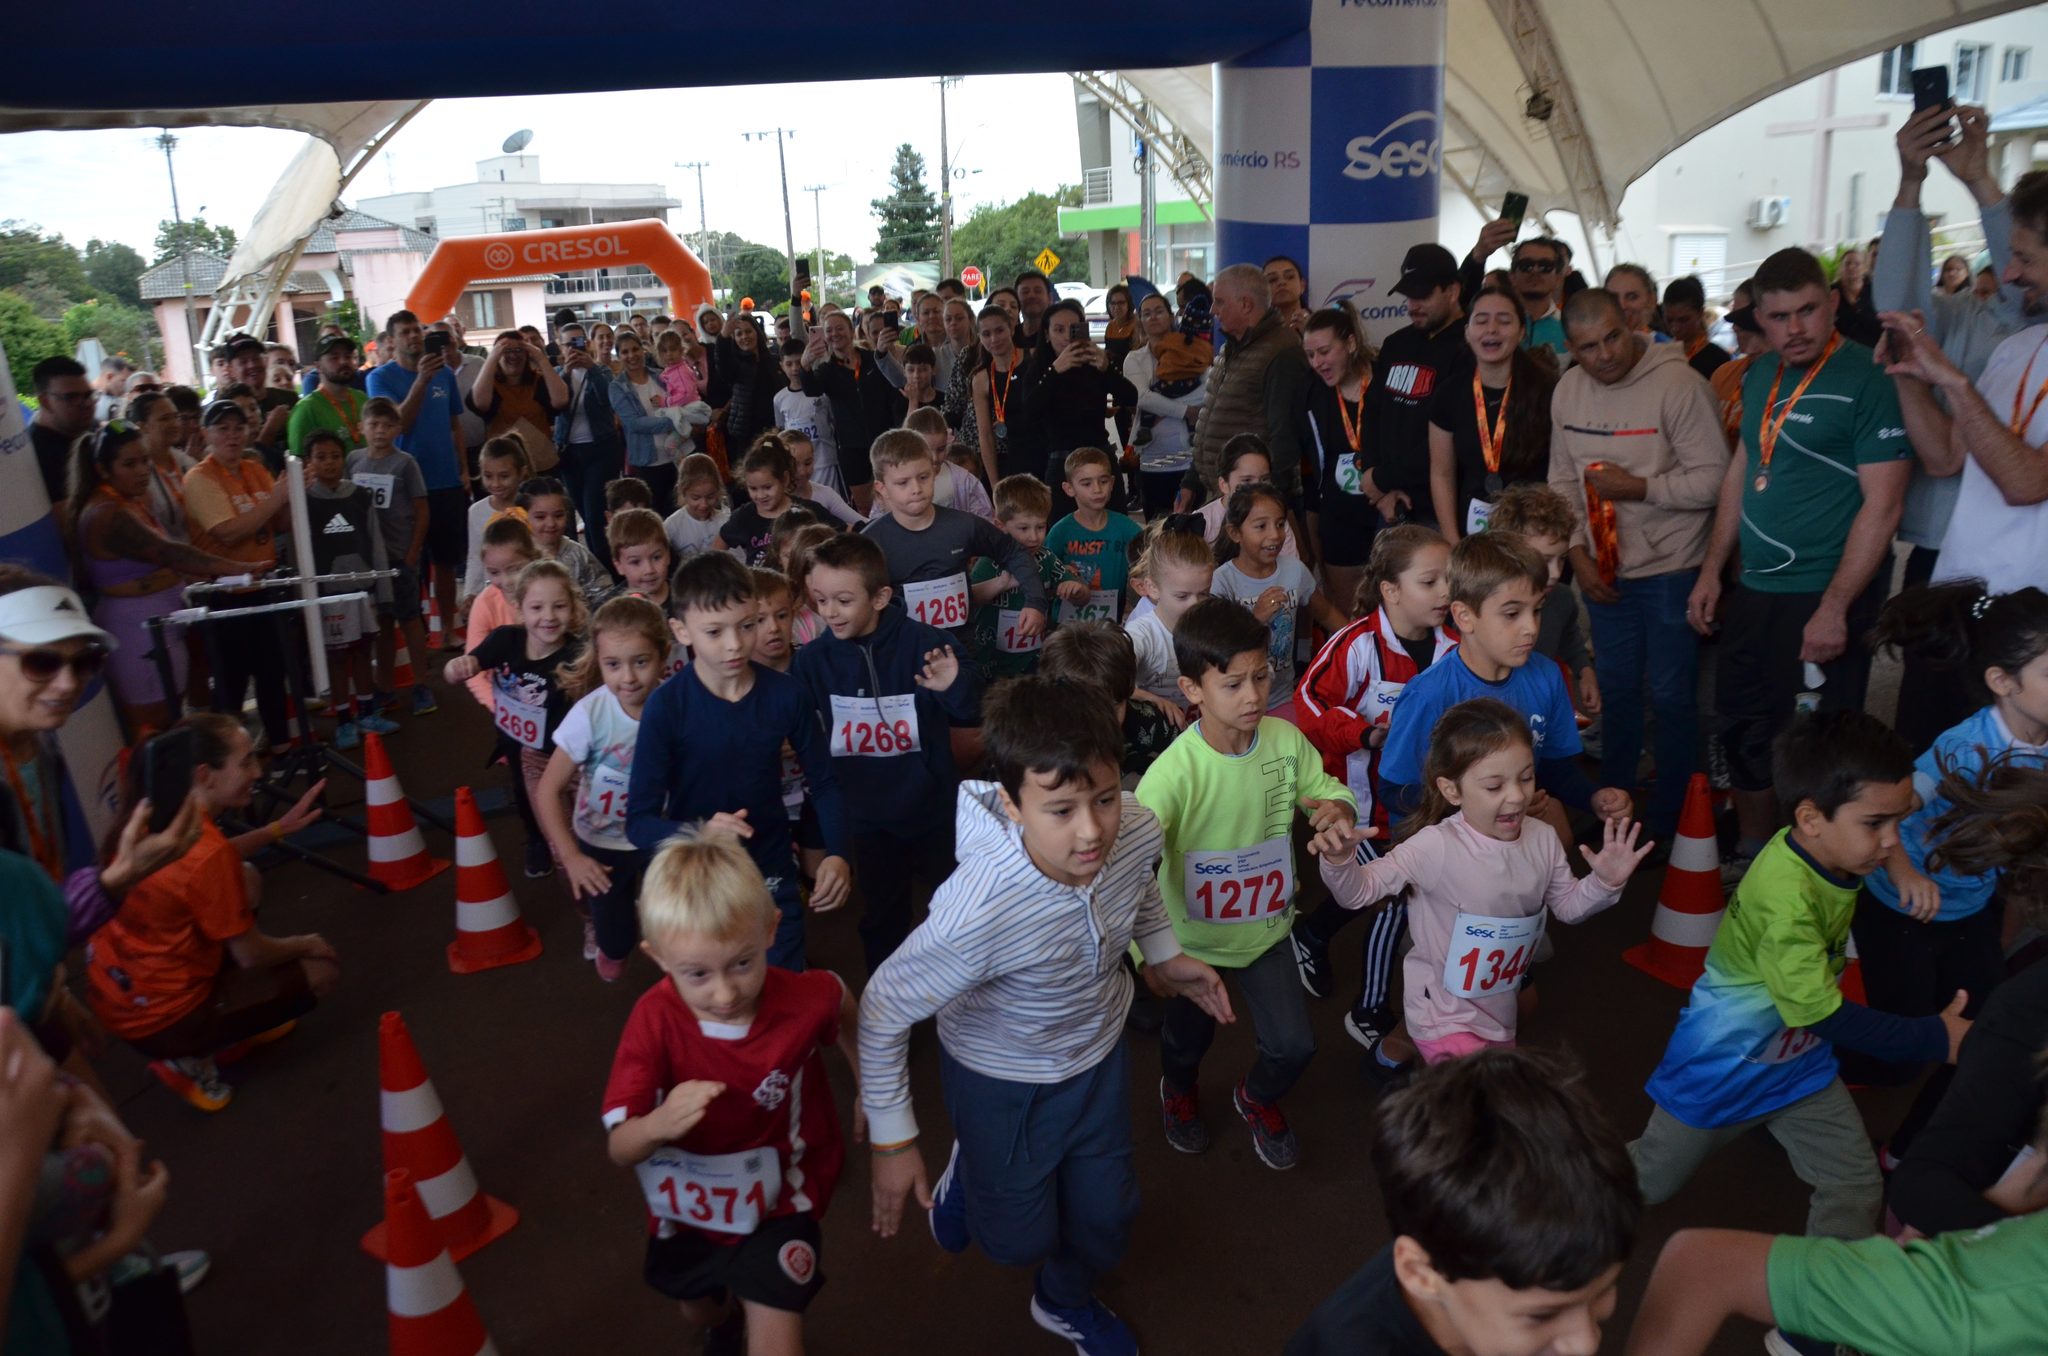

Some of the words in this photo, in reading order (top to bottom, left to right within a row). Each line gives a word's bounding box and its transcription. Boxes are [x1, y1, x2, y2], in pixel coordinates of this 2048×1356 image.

[1274, 150, 1301, 169] RS
[523, 235, 629, 264] CRESOL
[962, 272, 980, 281] PARE
[915, 591, 967, 625] 1265
[841, 719, 913, 753] 1268
[1195, 862, 1233, 875] Sesc
[1195, 869, 1286, 919] 1272
[1465, 924, 1496, 939] Sesc
[659, 1176, 767, 1225] 1371
